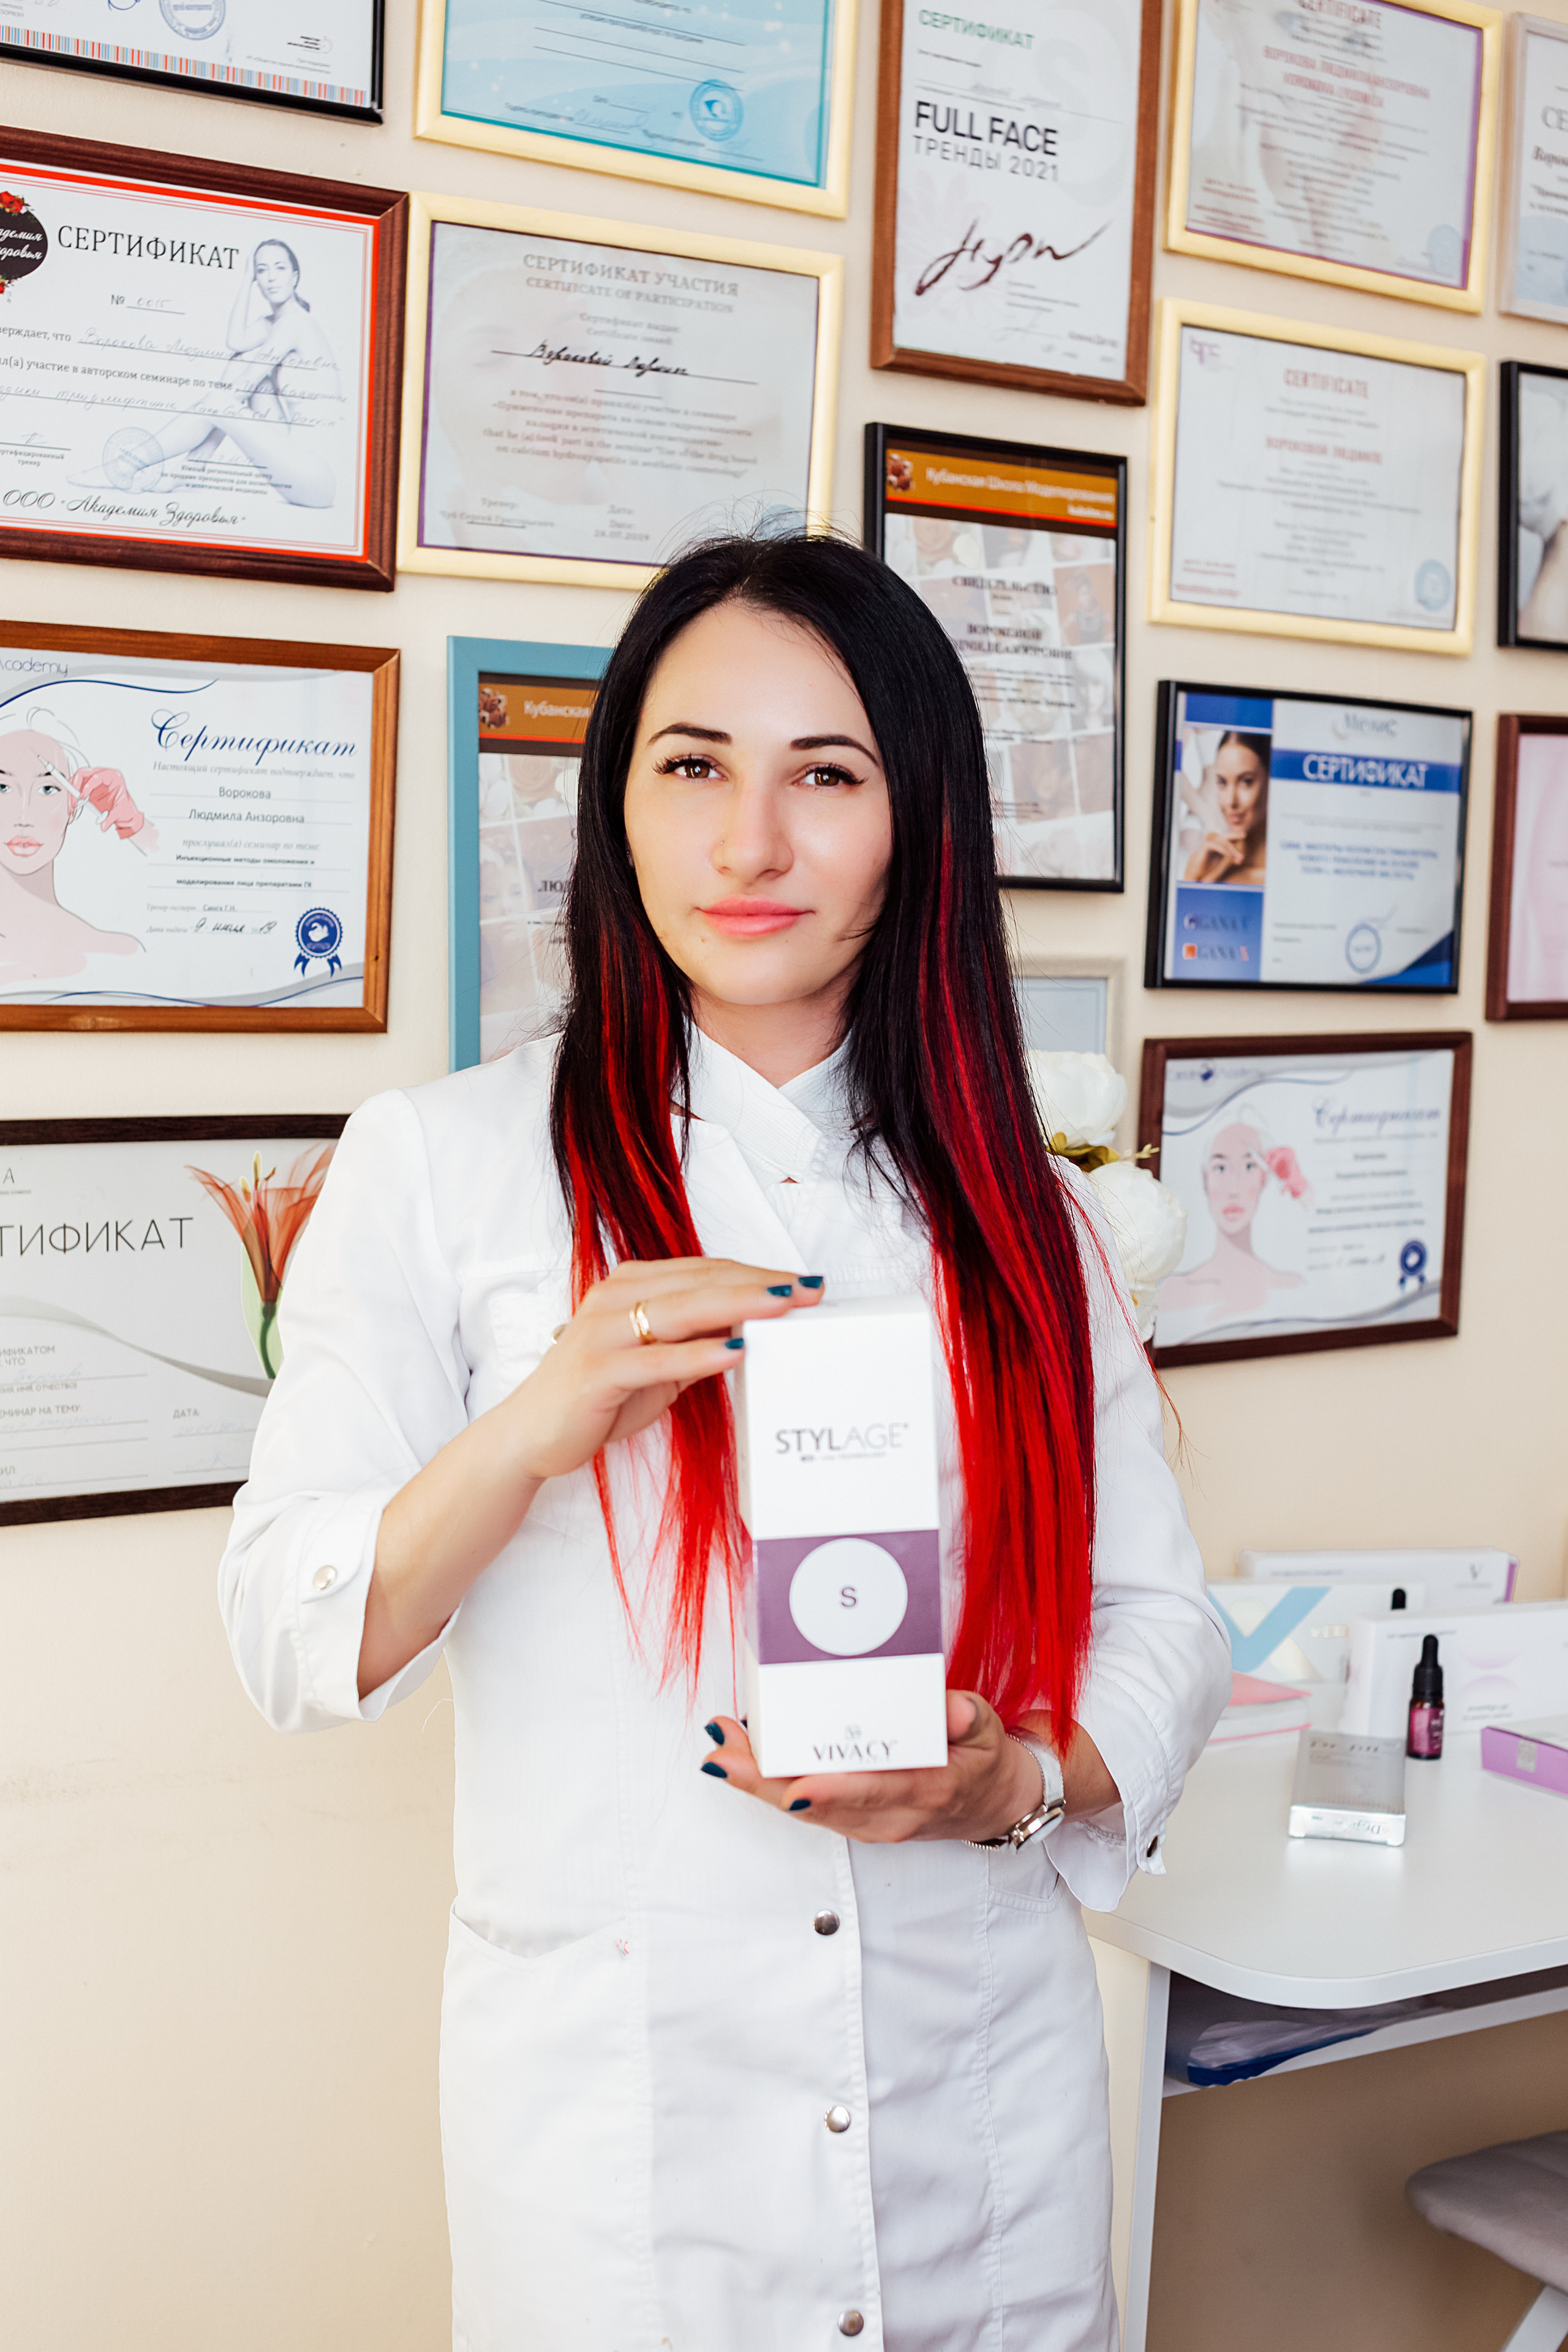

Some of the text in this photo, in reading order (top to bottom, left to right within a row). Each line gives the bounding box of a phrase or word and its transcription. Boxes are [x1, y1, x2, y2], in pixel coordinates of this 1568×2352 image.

[919, 9, 1035, 50] СЕРТИФИКАТ
[915, 100, 1058, 157] FULL FACE
[913, 134, 1058, 182] ТРЕНДЫ 2021
[58, 225, 239, 270] СЕРТИФИКАТ
[523, 253, 740, 296] СЕРТИФИКАТ УЧАСТИЯ
[526, 276, 734, 313] CERTIFICATE OF PARTICIPATION
[52, 333, 71, 342] что
[26, 360, 70, 372] участие
[81, 366, 137, 379] авторском
[140, 372, 191, 387] семинаре
[192, 378, 206, 388] по
[209, 380, 233, 390] теме
[1283, 368, 1369, 400] CERTIFICATE
[2, 489, 56, 510] ООО
[151, 709, 358, 766] Сертификат
[153, 761, 208, 773] Настоящий
[209, 764, 268, 776] сертификат
[1303, 753, 1429, 788] СЕРТИФИКАТ
[219, 786, 271, 800] Ворокова
[189, 809, 305, 824] Людмила Анзоровна
[176, 854, 231, 863] Инъекционные
[244, 841, 281, 851] семинар
[5, 1356, 26, 1366] ЧТО
[39, 1407, 52, 1415] НА
[840, 1586, 858, 1607] S
